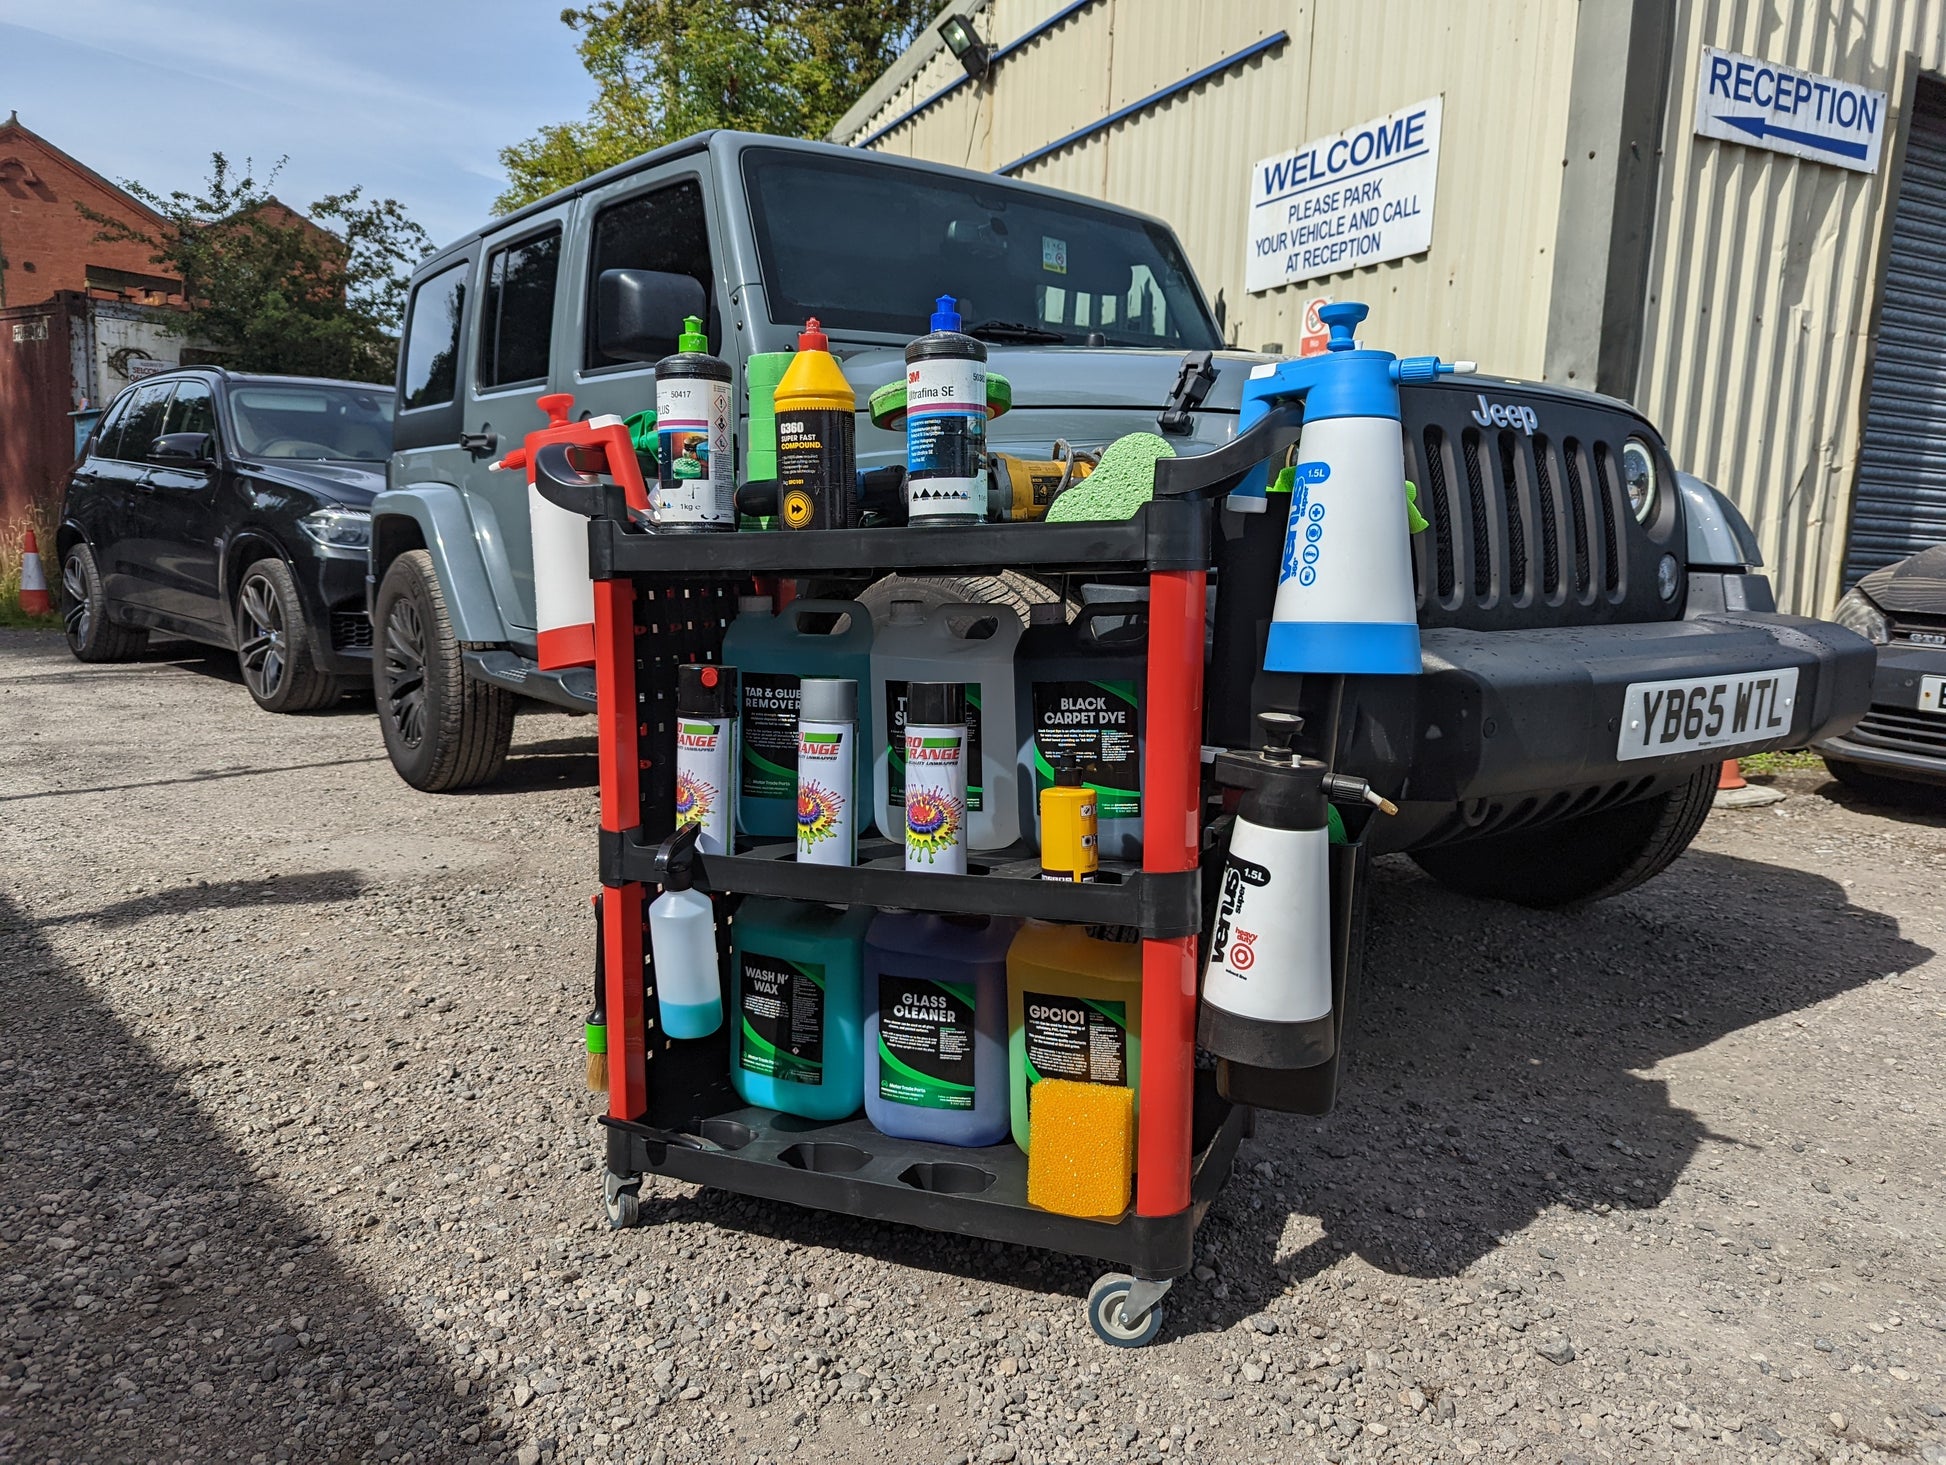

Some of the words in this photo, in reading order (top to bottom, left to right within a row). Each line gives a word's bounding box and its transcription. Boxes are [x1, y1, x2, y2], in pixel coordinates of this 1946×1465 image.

[1709, 56, 1878, 134] RECEPTION
[1264, 110, 1427, 195] WELCOME
[1288, 191, 1340, 224] PLEASE
[1343, 178, 1383, 208] PARK
[1256, 232, 1287, 257] YOUR
[1290, 215, 1345, 248] VEHICLE
[1347, 206, 1379, 233] AND
[1383, 195, 1421, 223] CALL
[1285, 252, 1301, 274] AT
[1303, 232, 1381, 269] RECEPTION
[909, 371, 920, 384] 3M
[942, 386, 954, 397] SE
[1471, 394, 1539, 437] Jeep
[781, 434, 798, 442] SUPER
[781, 441, 823, 450] COMPOUND.
[1308, 468, 1325, 478] 1.5L
[680, 502, 693, 511] 1kg
[1300, 486, 1309, 518] super
[1910, 633, 1946, 644] GTD
[745, 686, 762, 698] TAR
[764, 688, 772, 698] &
[775, 688, 800, 698] GLUE
[745, 698, 800, 710] REMOVER
[1060, 697, 1106, 710] BLACK
[1044, 712, 1096, 724] CARPET
[1099, 711, 1126, 724] DYE
[1642, 684, 1728, 746] YB65
[1732, 678, 1783, 734] WTL
[906, 736, 922, 748] RO
[909, 748, 960, 760] RANGE
[1244, 868, 1265, 882] 1.5L
[1235, 884, 1246, 914] super
[1235, 926, 1258, 940] heavy
[1236, 934, 1254, 946] duty
[745, 966, 775, 982] WASH
[754, 980, 778, 996] WAX
[902, 992, 947, 1008] GLASS
[893, 1004, 956, 1022] CLEANER
[1029, 1004, 1085, 1025] GPC101
